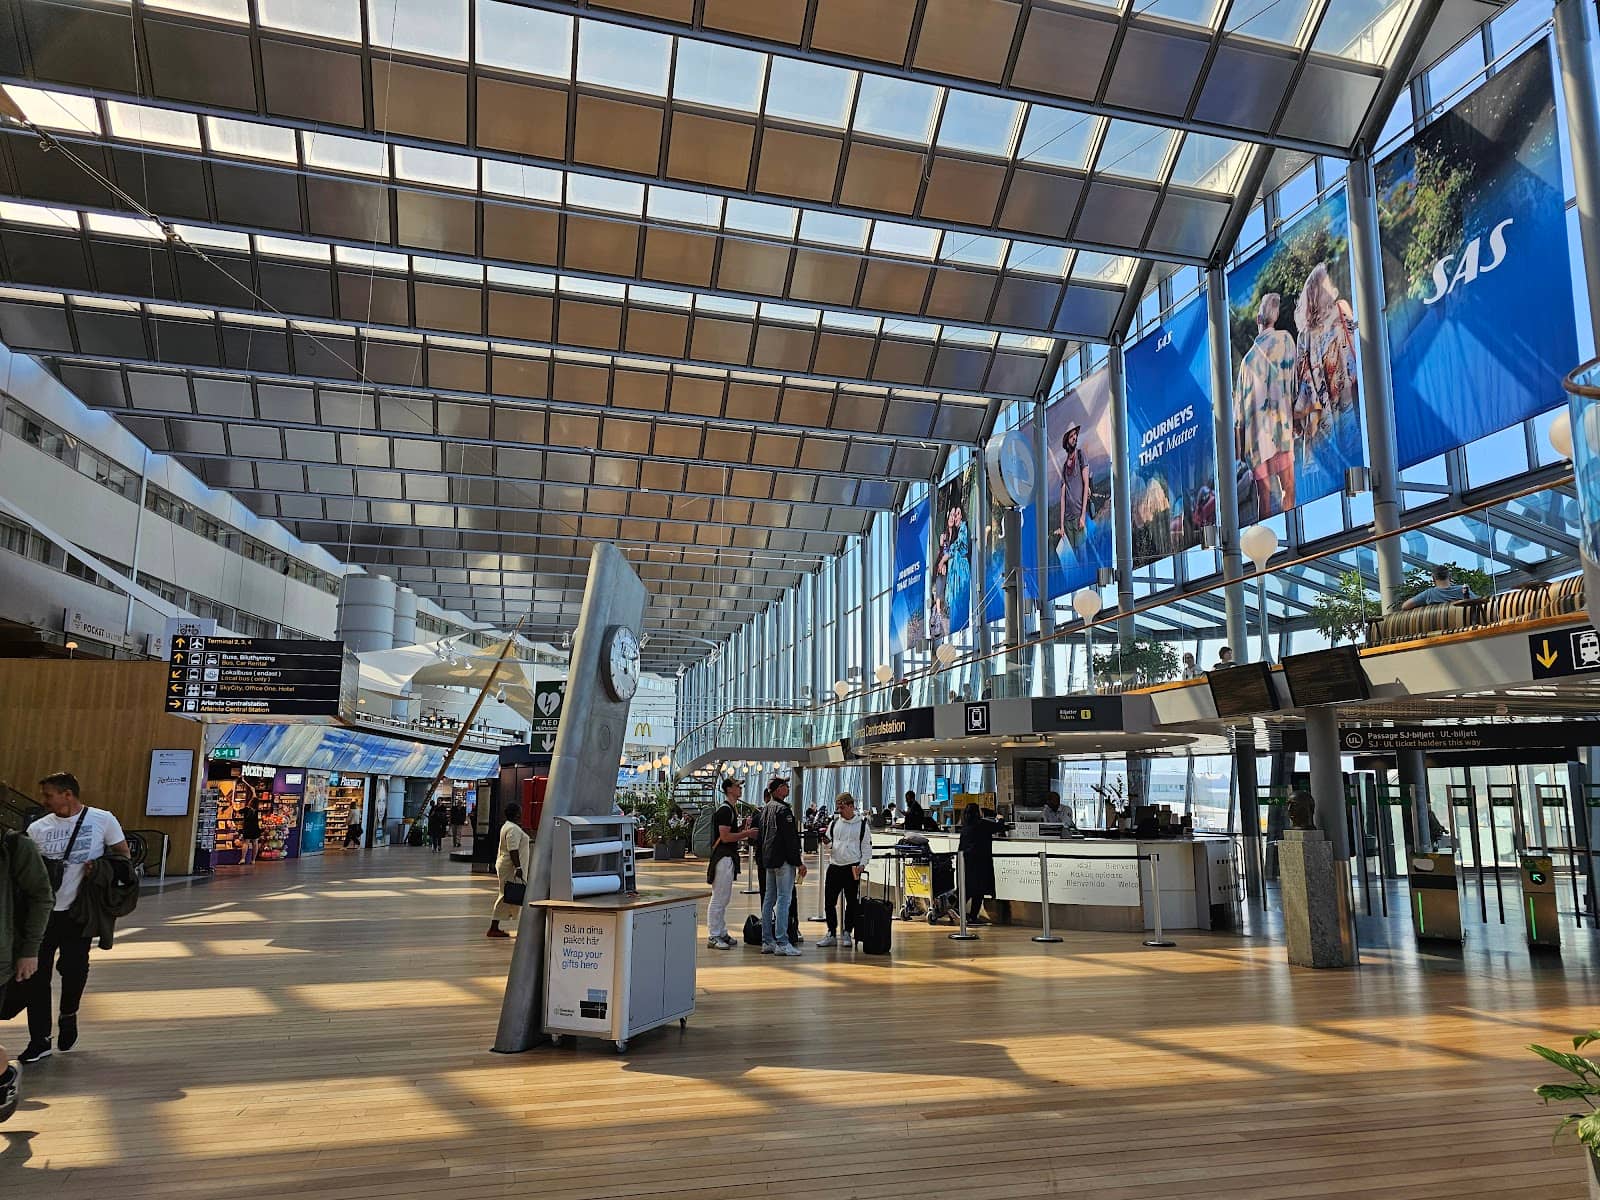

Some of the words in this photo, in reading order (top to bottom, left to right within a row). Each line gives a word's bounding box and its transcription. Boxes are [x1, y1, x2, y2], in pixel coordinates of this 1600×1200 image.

[1423, 218, 1513, 304] SAS
[1155, 330, 1173, 353] SAS
[1140, 405, 1194, 448] JOURNEYS
[1138, 441, 1165, 467] THAT
[1166, 424, 1199, 452] Matter
[865, 719, 906, 737] Centralstation
[1367, 732, 1399, 741] Passage
[1399, 731, 1435, 740] SJ-biljett
[1439, 730, 1478, 739] UL-biljett
[1368, 740, 1379, 748] SJ
[1395, 740, 1417, 748] ticket
[1418, 739, 1448, 747] holders
[1447, 738, 1463, 746] this
[1463, 739, 1481, 747] way
[562, 948, 584, 960] Wrap
[584, 951, 604, 961] your
[561, 959, 579, 970] gifts
[579, 960, 599, 970] here
